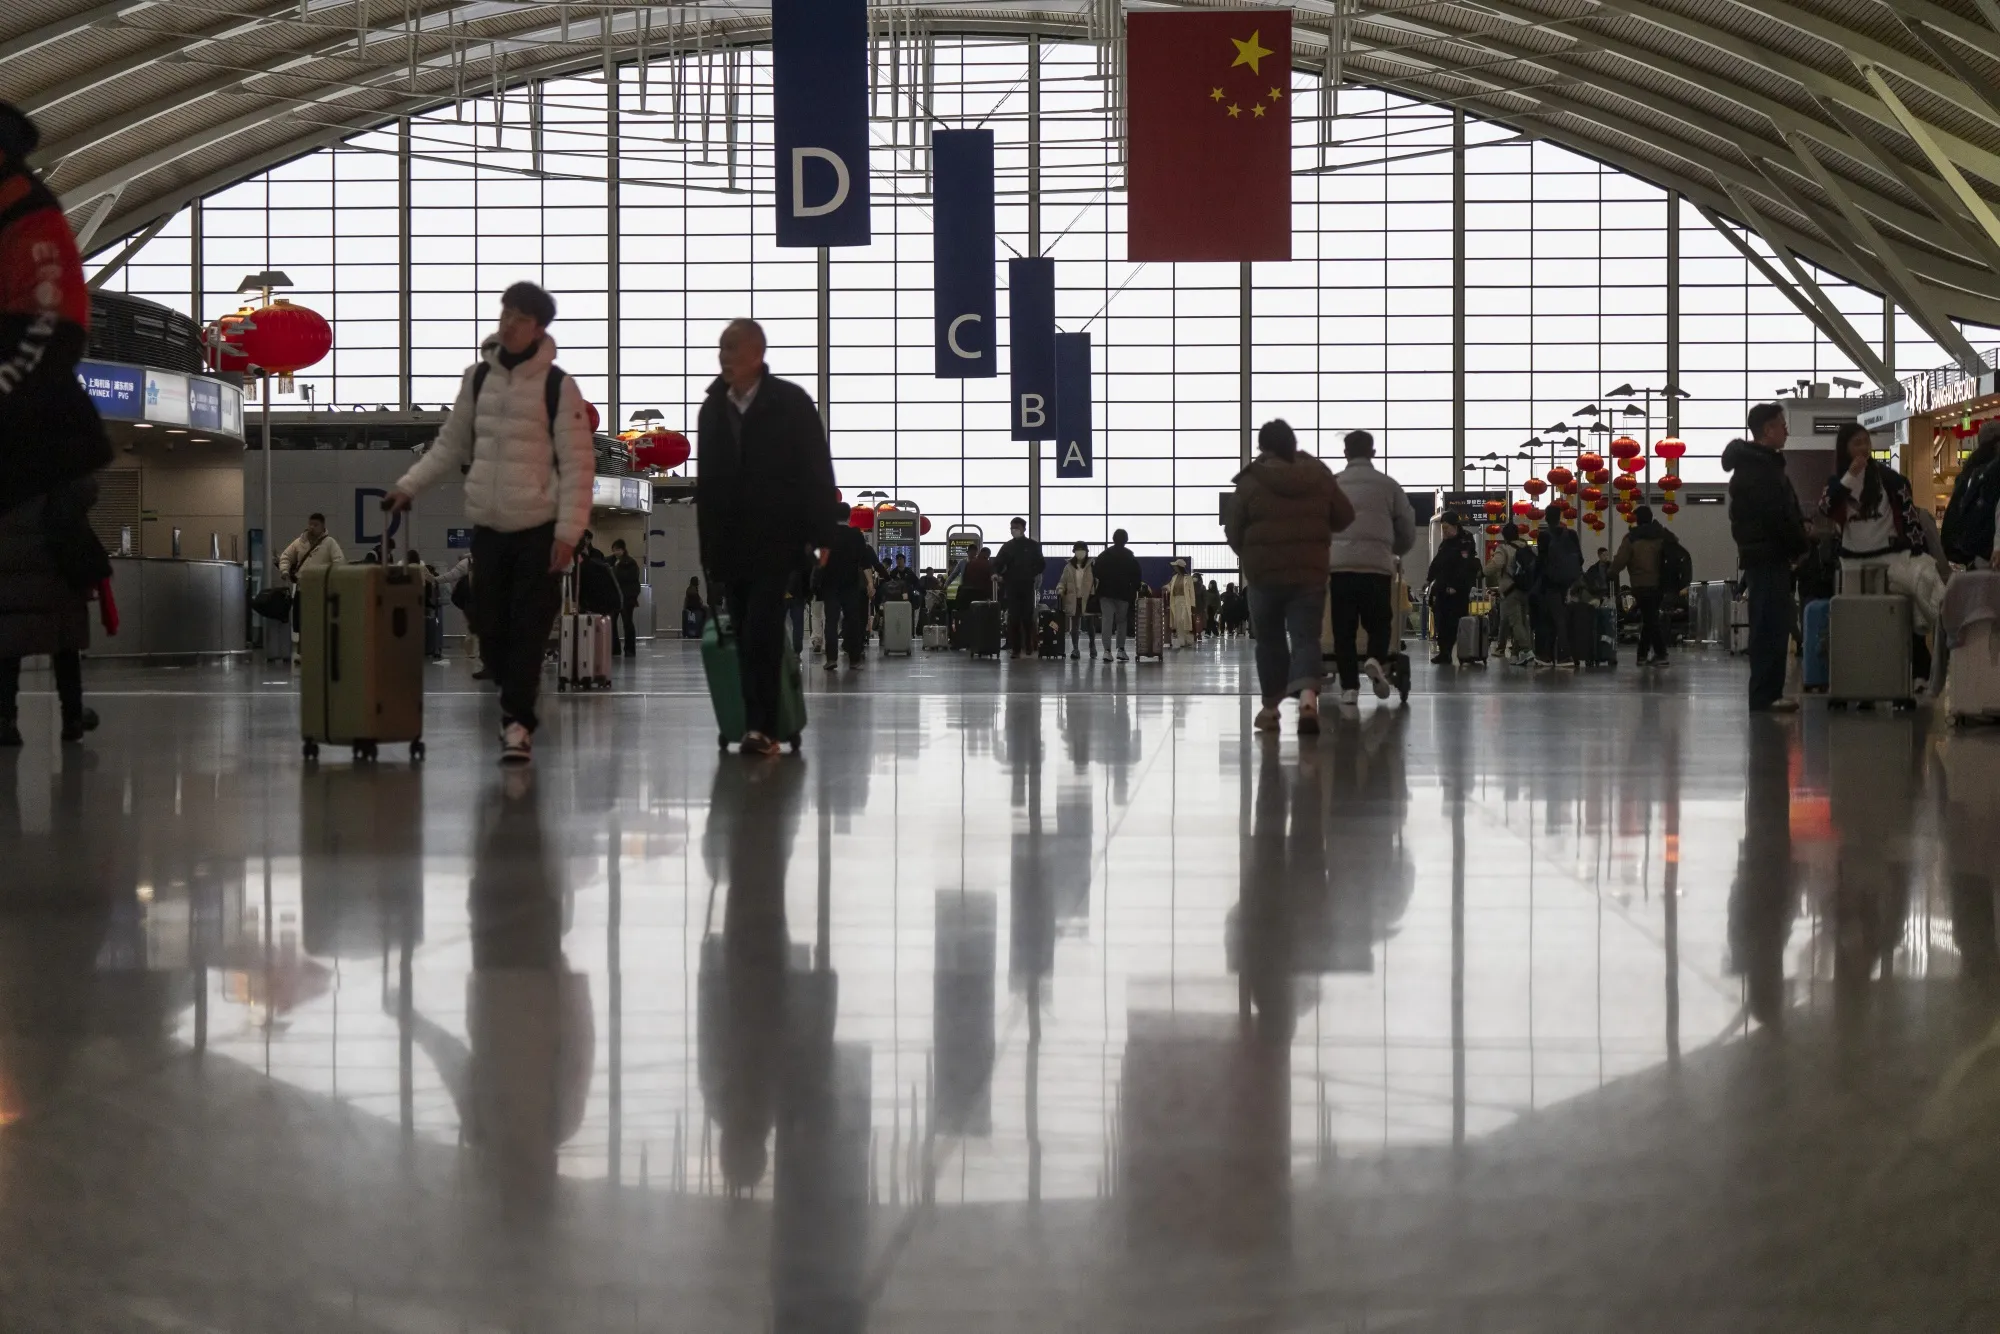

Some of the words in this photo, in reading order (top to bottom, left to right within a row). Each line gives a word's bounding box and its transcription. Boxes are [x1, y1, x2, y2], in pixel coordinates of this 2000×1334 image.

[792, 147, 850, 217] D
[948, 314, 981, 358] C
[88, 389, 110, 398] AVINEX
[118, 392, 129, 400] PVG
[1021, 393, 1046, 428] B
[1062, 441, 1086, 467] A
[355, 488, 401, 543] D
[879, 520, 885, 528] B
